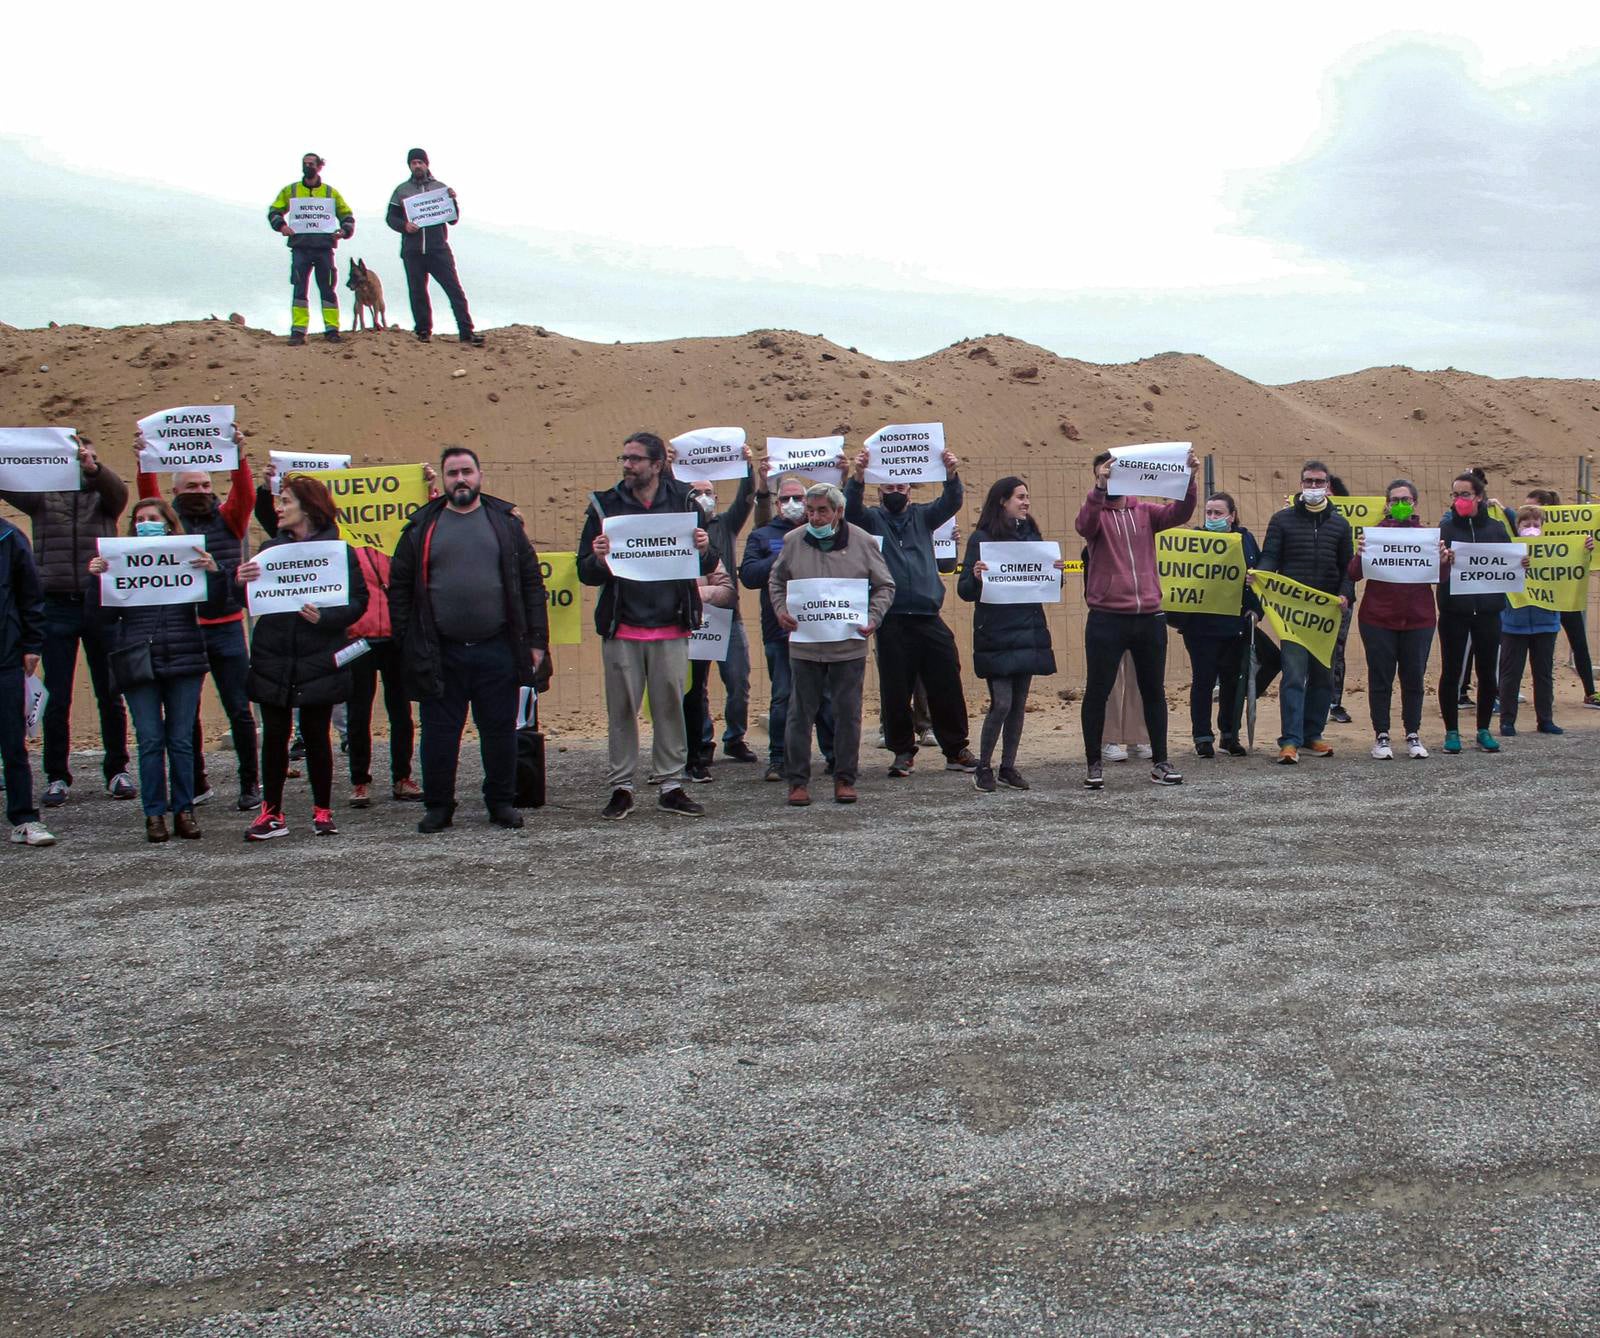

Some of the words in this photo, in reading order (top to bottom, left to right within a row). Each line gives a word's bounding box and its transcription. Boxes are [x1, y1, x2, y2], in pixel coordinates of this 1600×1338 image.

[165, 414, 211, 424] PLAYAS
[157, 427, 220, 438] VÍRGENES
[879, 432, 930, 442] NOSOTROS
[168, 441, 212, 451] AHORA
[687, 445, 719, 457] ¿QUIÉN
[720, 445, 732, 453] ES
[880, 444, 930, 454] CUIDAMOS
[160, 454, 223, 465] VIOLADAS
[788, 449, 826, 459] NUEVO
[0, 456, 69, 465] UTOGESTIÓN
[292, 461, 317, 469] ESTO
[318, 461, 330, 469] ES
[679, 458, 690, 466] EL
[690, 454, 740, 465] CULPABLE?
[881, 455, 929, 465] NUESTRAS
[889, 467, 923, 476] PLAYAS
[1118, 460, 1185, 473] SEGREGACIÓN
[337, 502, 420, 525] NICIPIO
[626, 537, 677, 548] CRIMEN
[1160, 535, 1228, 554] NUEVO
[611, 549, 693, 560] MEDIOAMBIENTAL
[1383, 545, 1422, 554] DELITO
[127, 554, 154, 568] NO
[157, 553, 181, 566] AL
[266, 558, 329, 571] QUEREMOS
[1371, 558, 1433, 567] AMBIENTAL
[1469, 556, 1490, 566] NO
[1491, 556, 1508, 566] AL
[1000, 563, 1042, 573] CRIMEN
[1158, 561, 1240, 580] UNICIPIO
[1524, 565, 1585, 581] NICIPIO
[116, 574, 193, 589] EXPOLIO
[277, 573, 317, 584] NUEVO
[987, 574, 1055, 583] MEDIOAMBIENTAL
[1460, 571, 1516, 581] EXPOLIO
[254, 583, 342, 599] AYUNTAMIENTO
[1170, 587, 1204, 604] ¡YA!
[802, 600, 837, 611] ¿QUIÉN
[838, 600, 850, 608] ES
[797, 614, 807, 622] EL
[807, 613, 859, 621] CULPABLE?
[688, 632, 722, 642] NTADO
